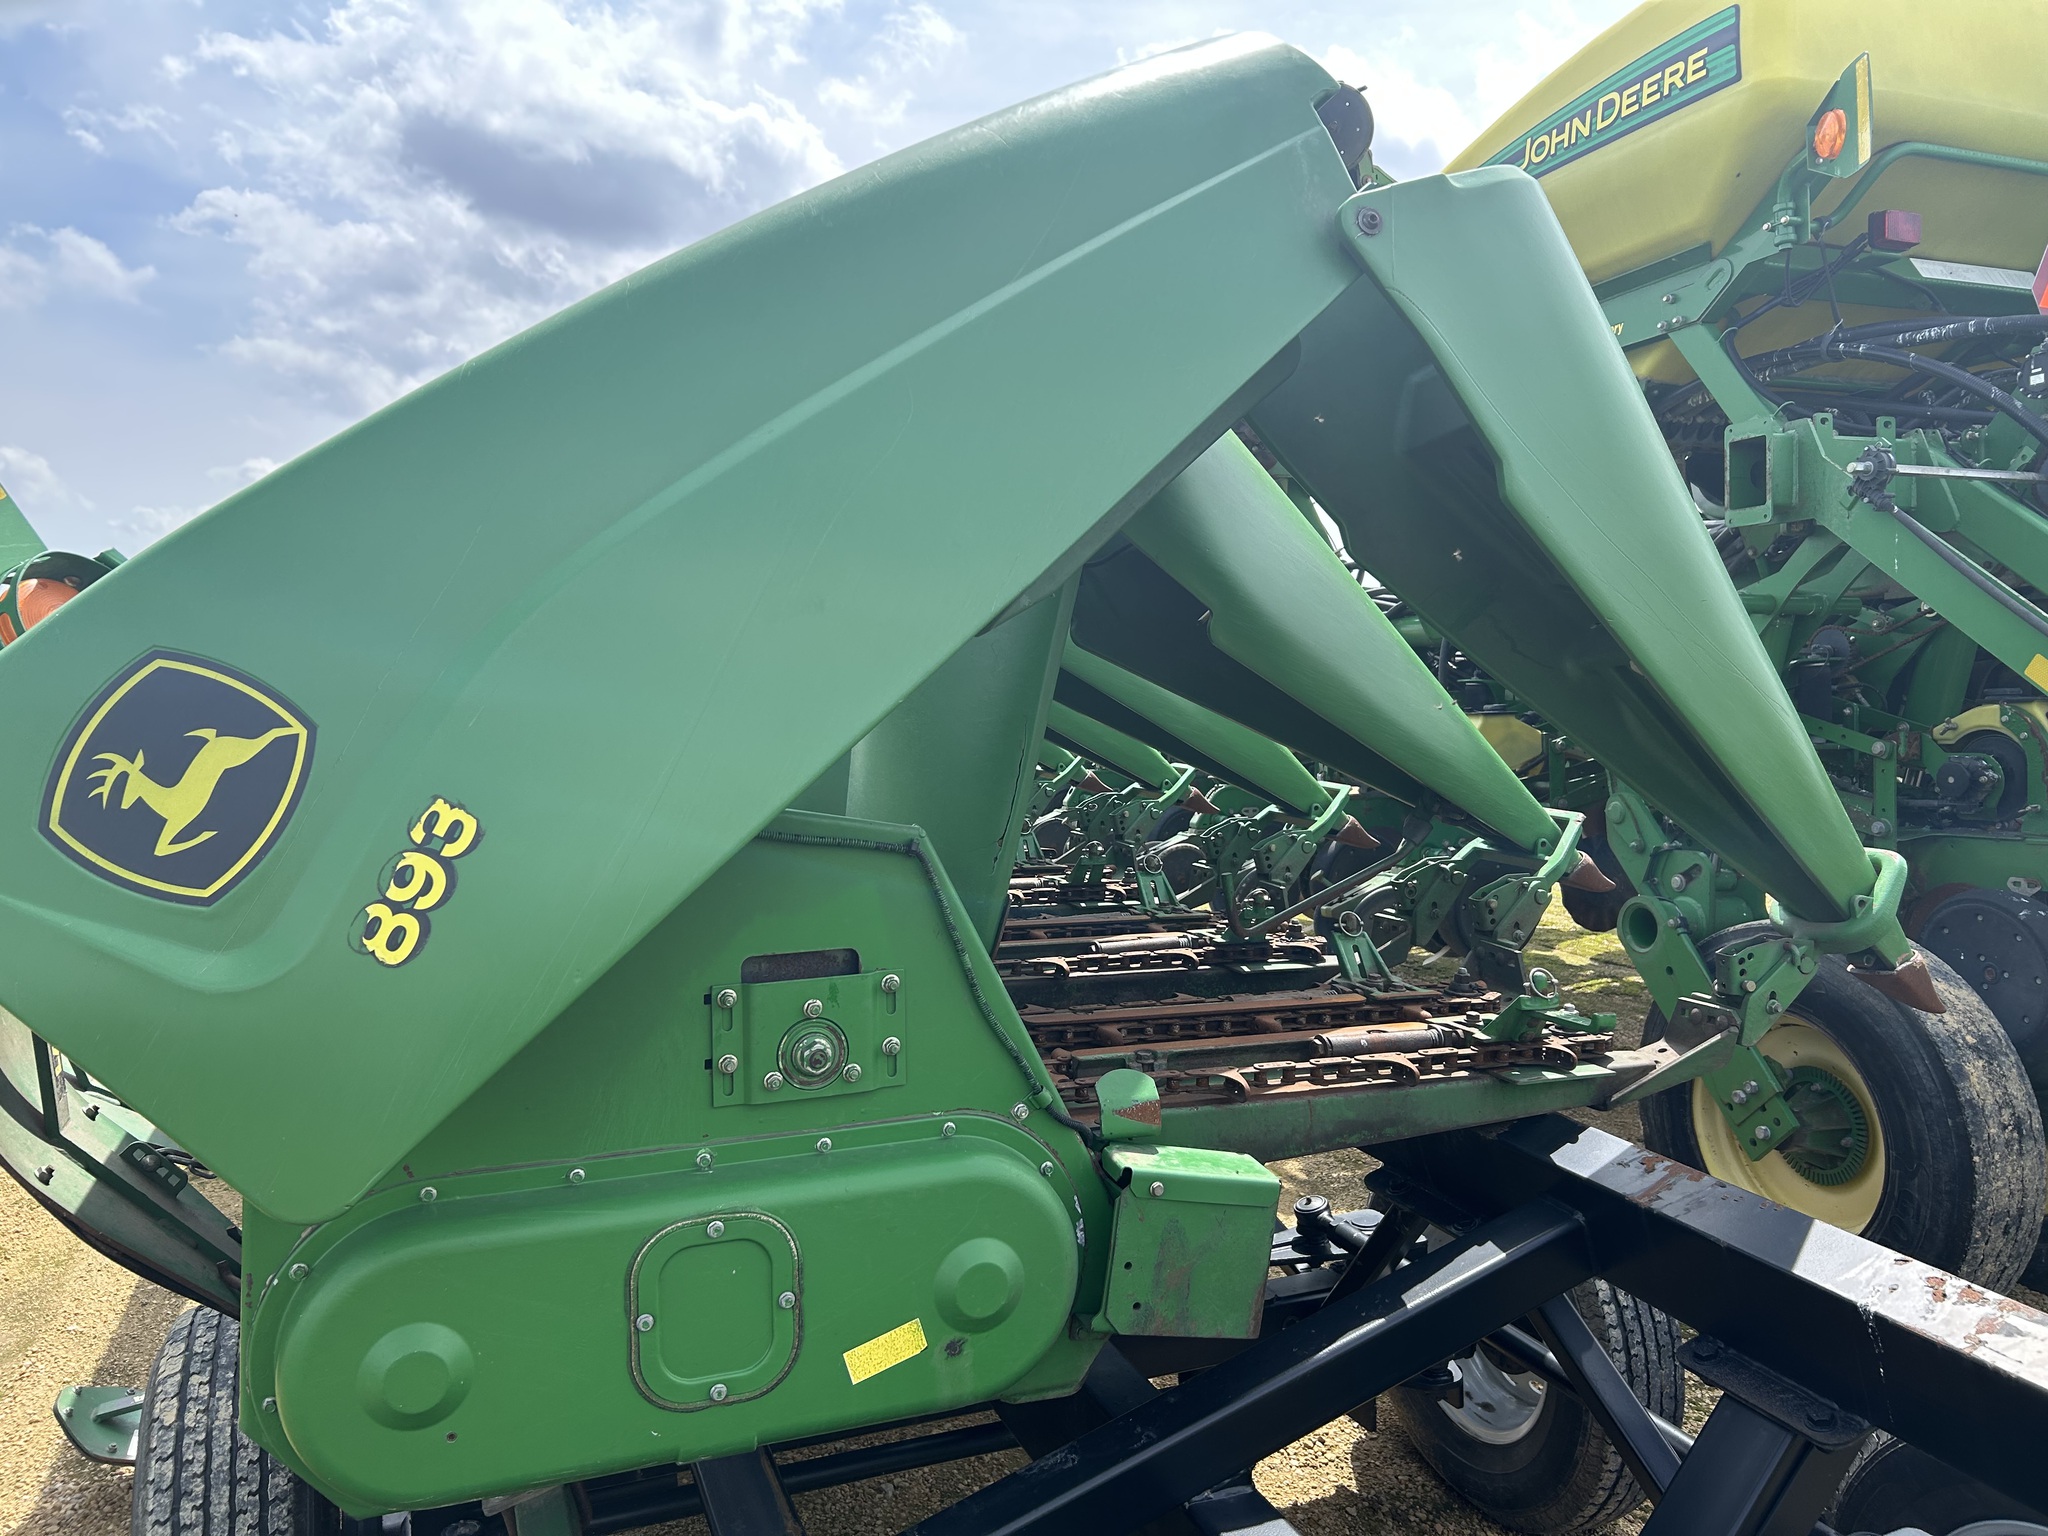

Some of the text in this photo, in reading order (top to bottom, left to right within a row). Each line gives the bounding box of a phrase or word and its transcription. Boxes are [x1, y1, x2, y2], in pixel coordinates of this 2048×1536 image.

[1518, 46, 1710, 170] JOHN DEERE
[349, 795, 483, 967] 893
